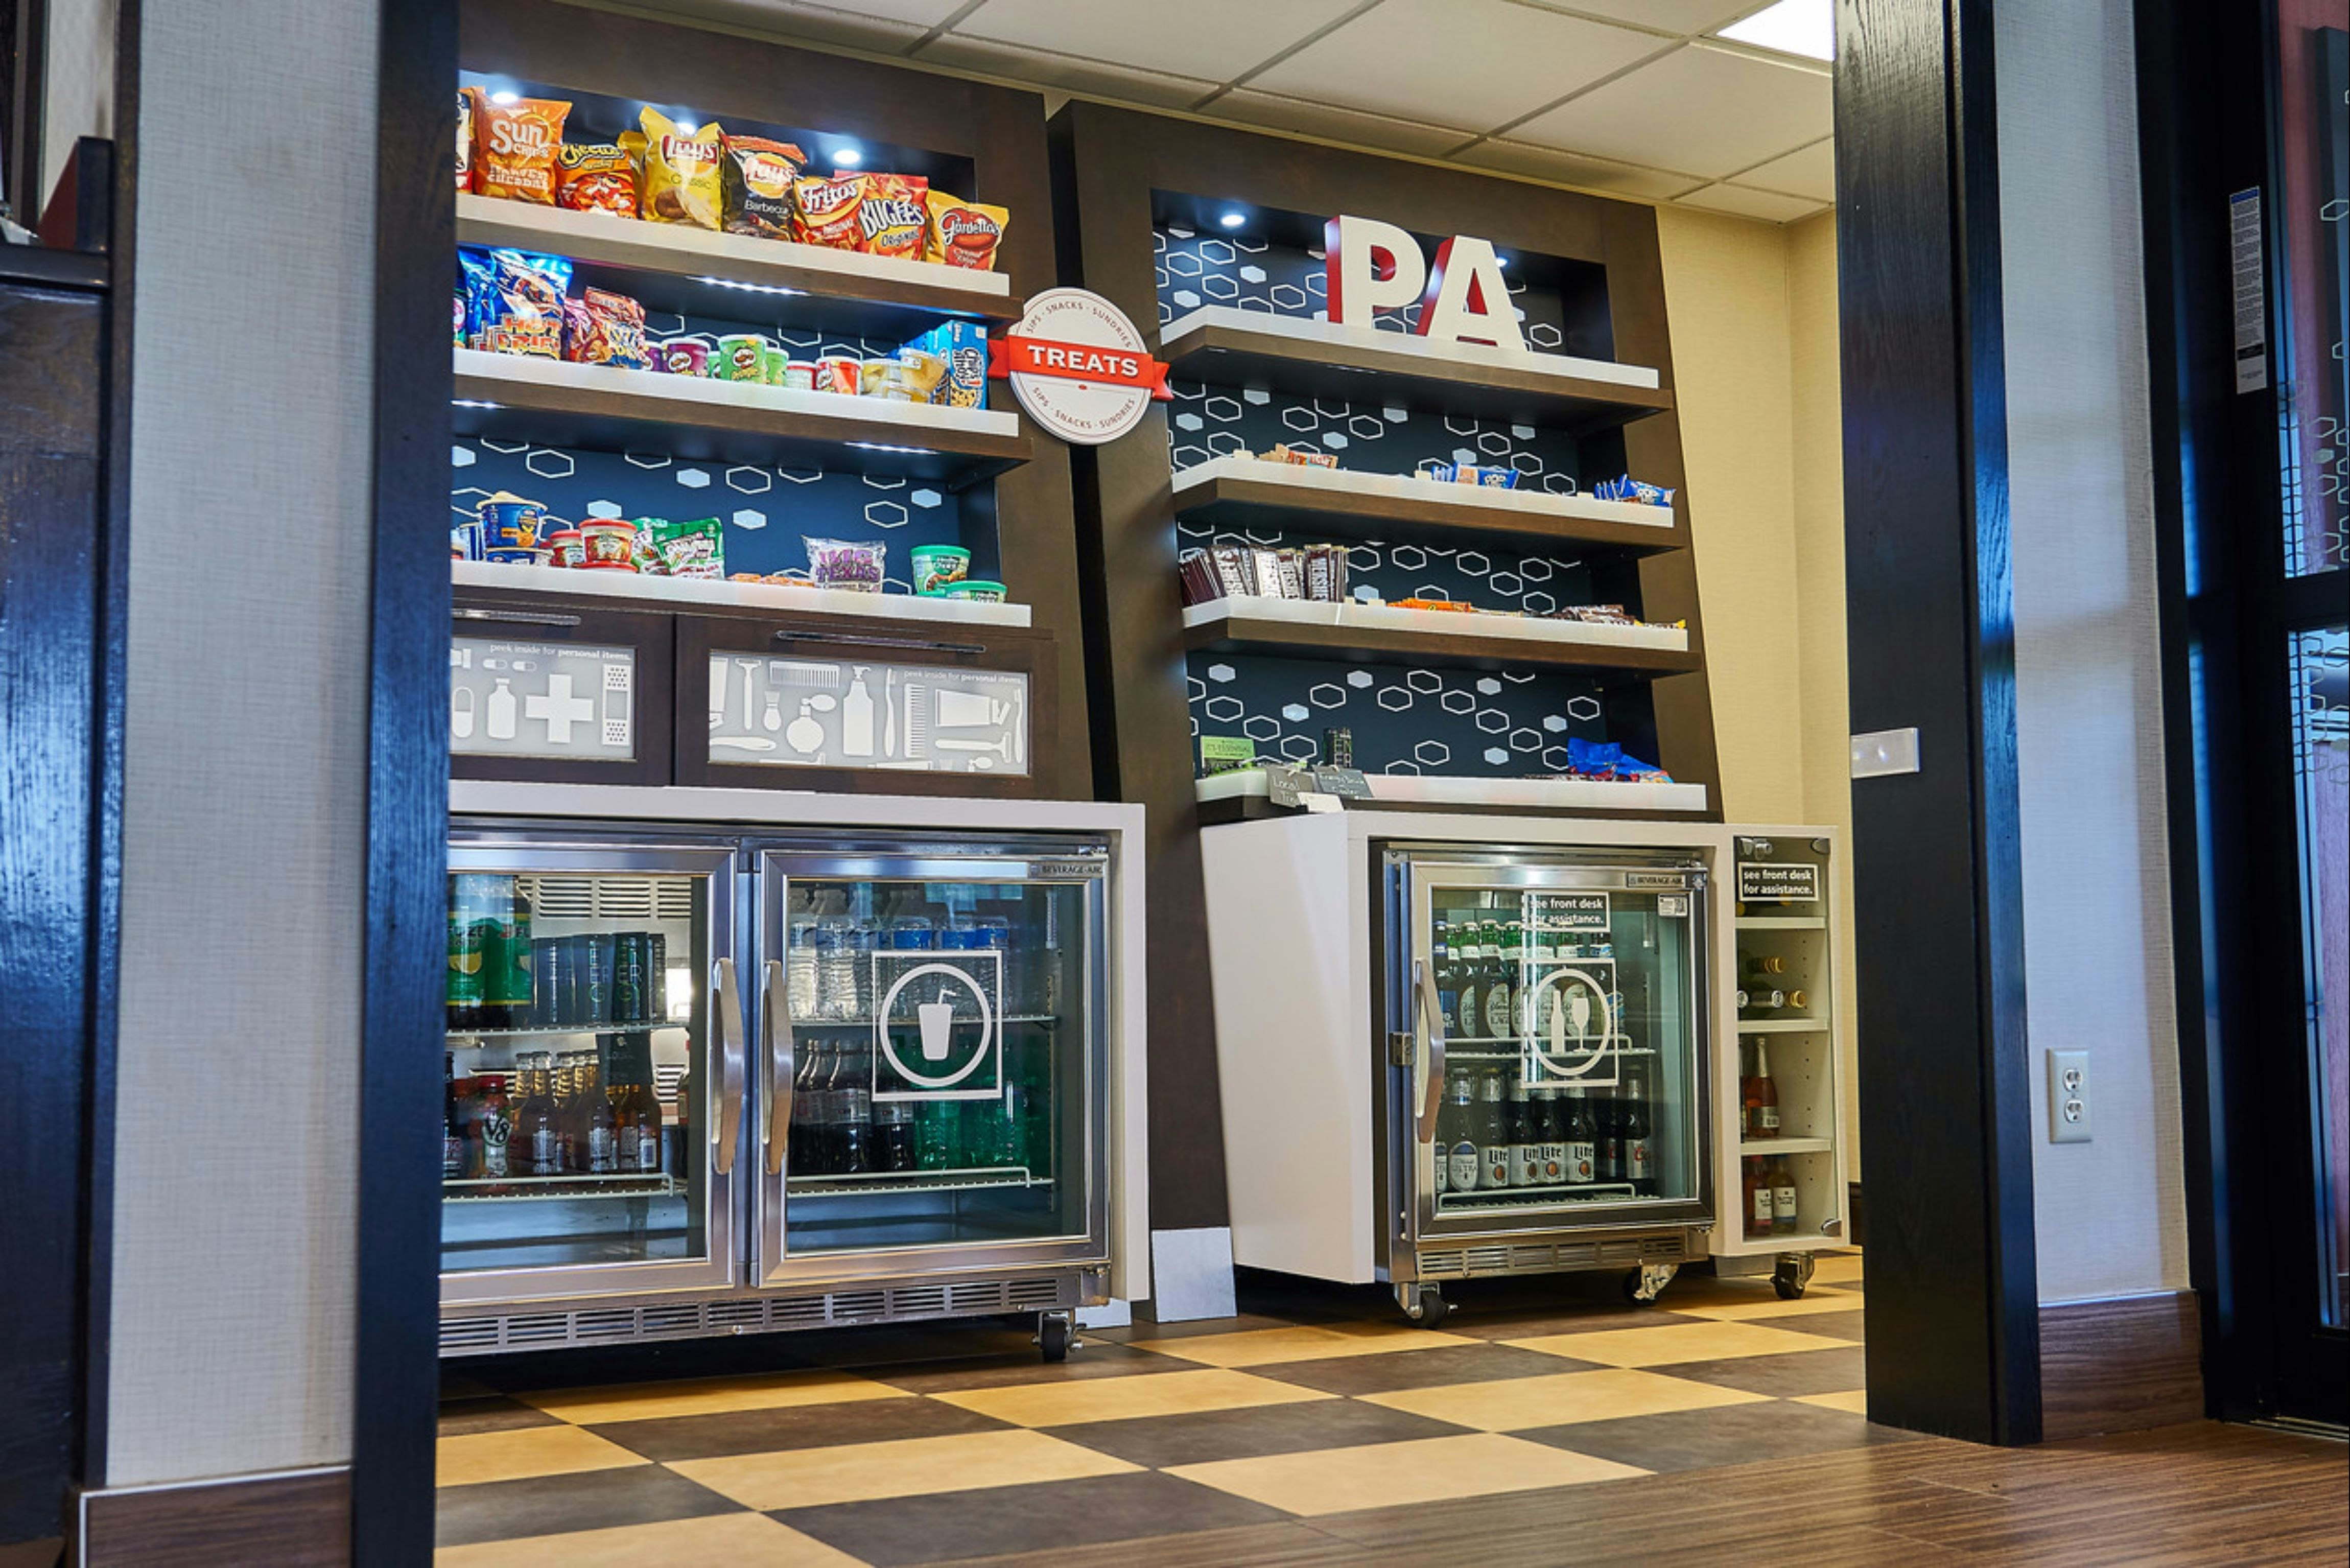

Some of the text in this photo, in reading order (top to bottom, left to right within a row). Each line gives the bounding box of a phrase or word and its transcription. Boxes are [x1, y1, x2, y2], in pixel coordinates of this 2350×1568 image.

[489, 119, 549, 154] Sun
[799, 180, 858, 215] Fritos
[1026, 301, 1132, 347] SIPS SNACKS SUNDRIES
[1027, 344, 1139, 378] TREATS
[1055, 409, 1092, 429] SNACKS
[1099, 398, 1135, 428] SUNDRIES
[816, 566, 880, 581] TEXAS
[490, 644, 511, 653] peek
[514, 645, 541, 654] inside
[543, 646, 556, 655] for
[558, 648, 600, 659] personal
[960, 673, 997, 682] personal
[1744, 869, 1812, 880] see front desk
[1744, 883, 1813, 894] for assistance.
[1550, 897, 1578, 908] front
[1579, 898, 1604, 909] desk
[1548, 913, 1604, 924] assistance.
[485, 1114, 509, 1143] V8
[1541, 1146, 1562, 1160] Lite
